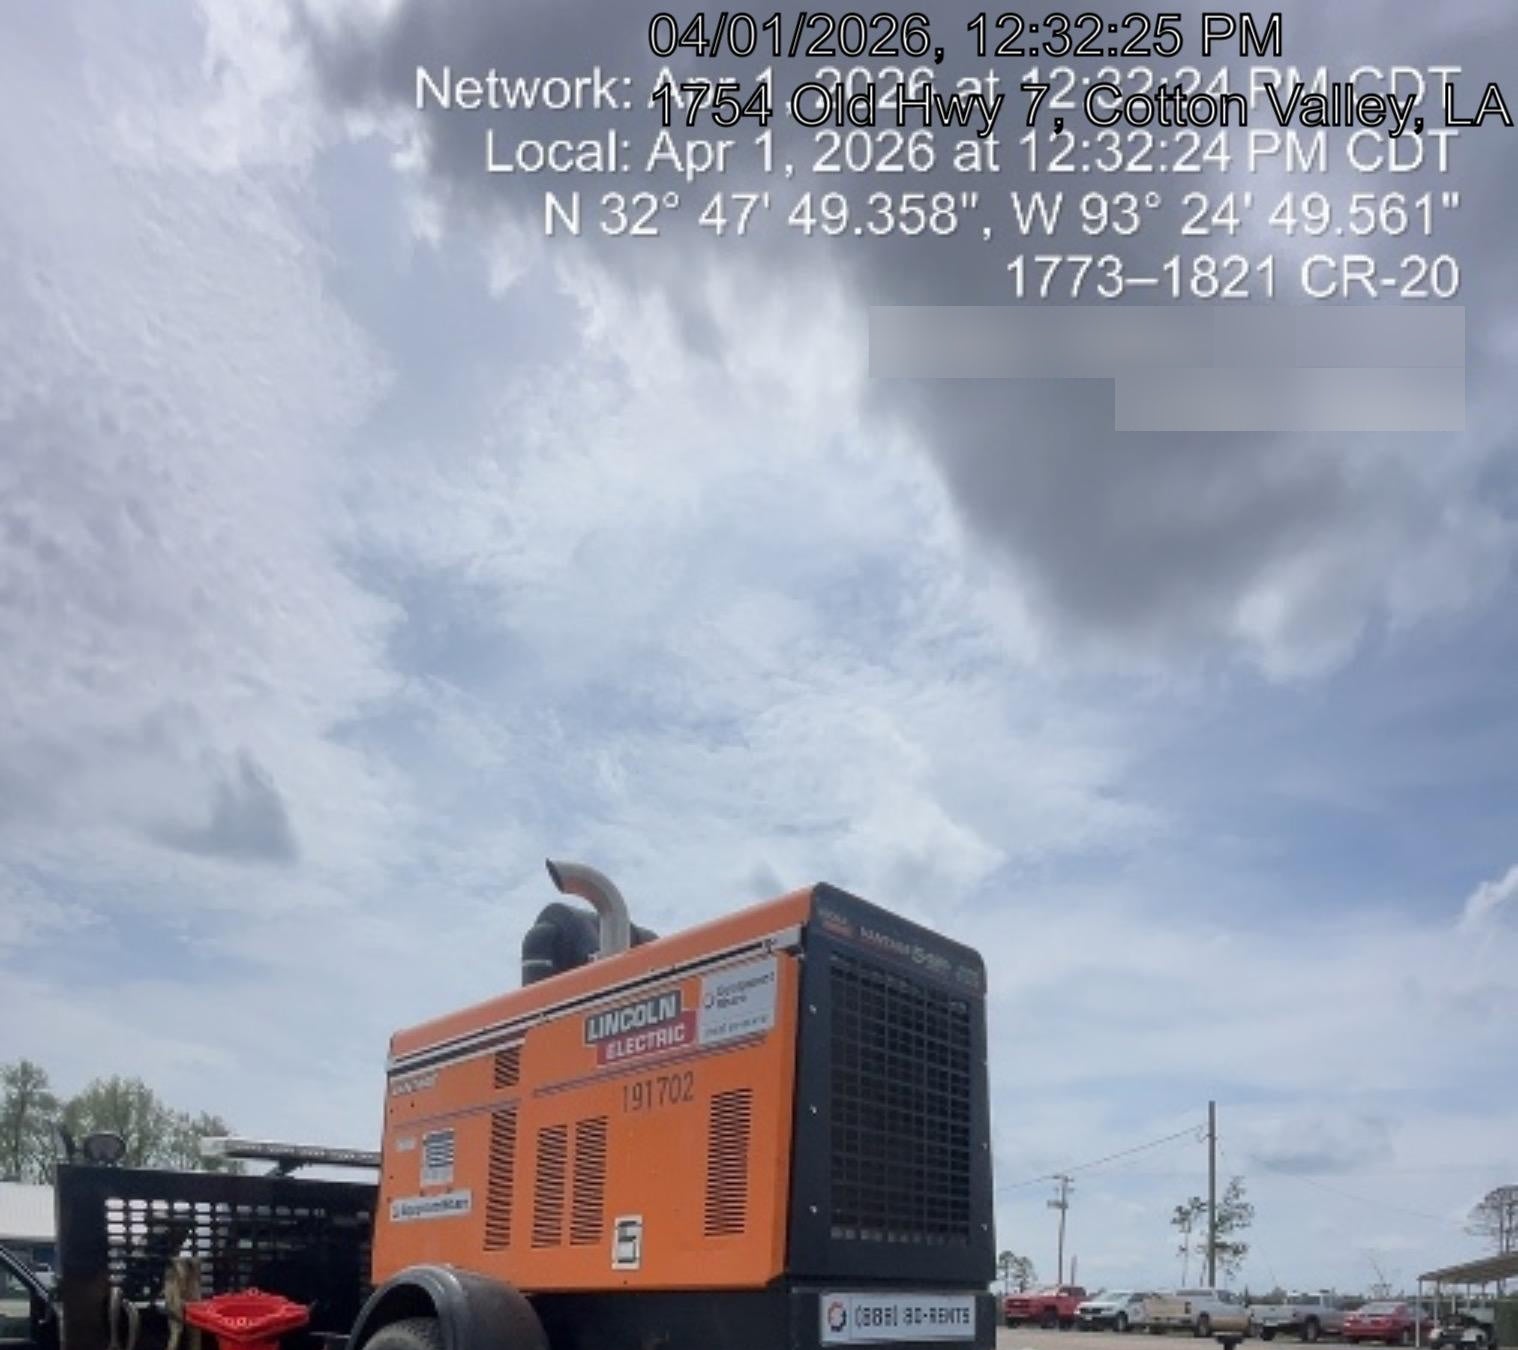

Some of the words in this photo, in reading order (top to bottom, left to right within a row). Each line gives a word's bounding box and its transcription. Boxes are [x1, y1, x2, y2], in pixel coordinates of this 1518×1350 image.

[588, 995, 677, 1042] LINCOLN
[605, 1024, 686, 1060] ELECTRIC
[623, 1071, 695, 1113] 191702
